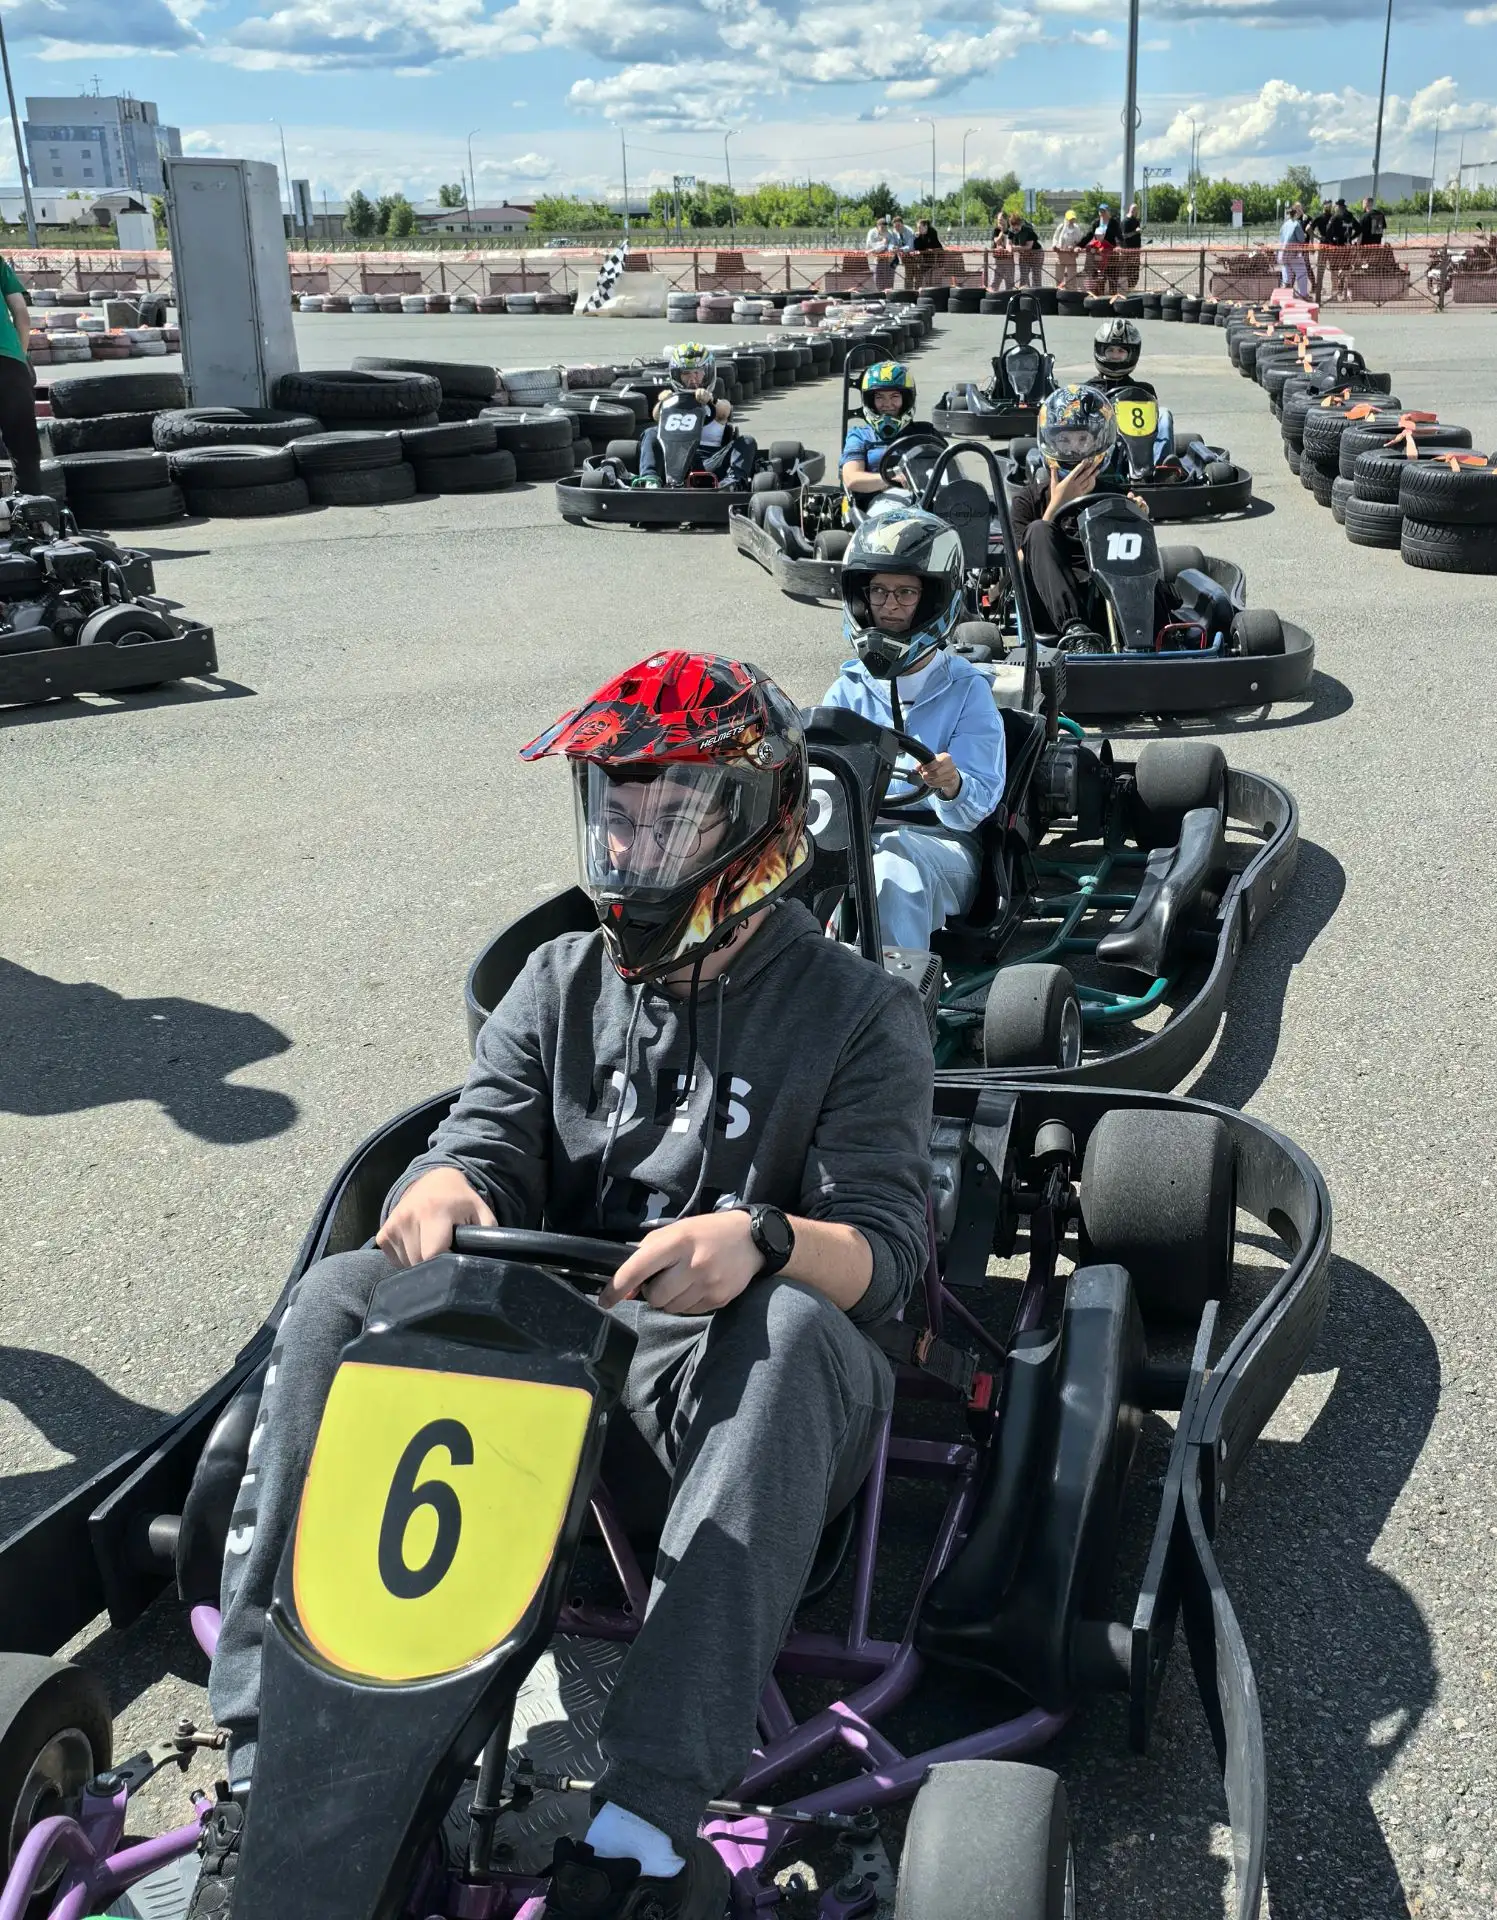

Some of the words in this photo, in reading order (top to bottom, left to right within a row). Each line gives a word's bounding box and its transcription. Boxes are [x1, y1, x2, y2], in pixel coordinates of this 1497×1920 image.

[664, 413, 698, 432] 69
[1132, 407, 1145, 429] 8
[1106, 532, 1143, 561] 10
[700, 724, 746, 749] HELMETS
[378, 1418, 474, 1599] 6
